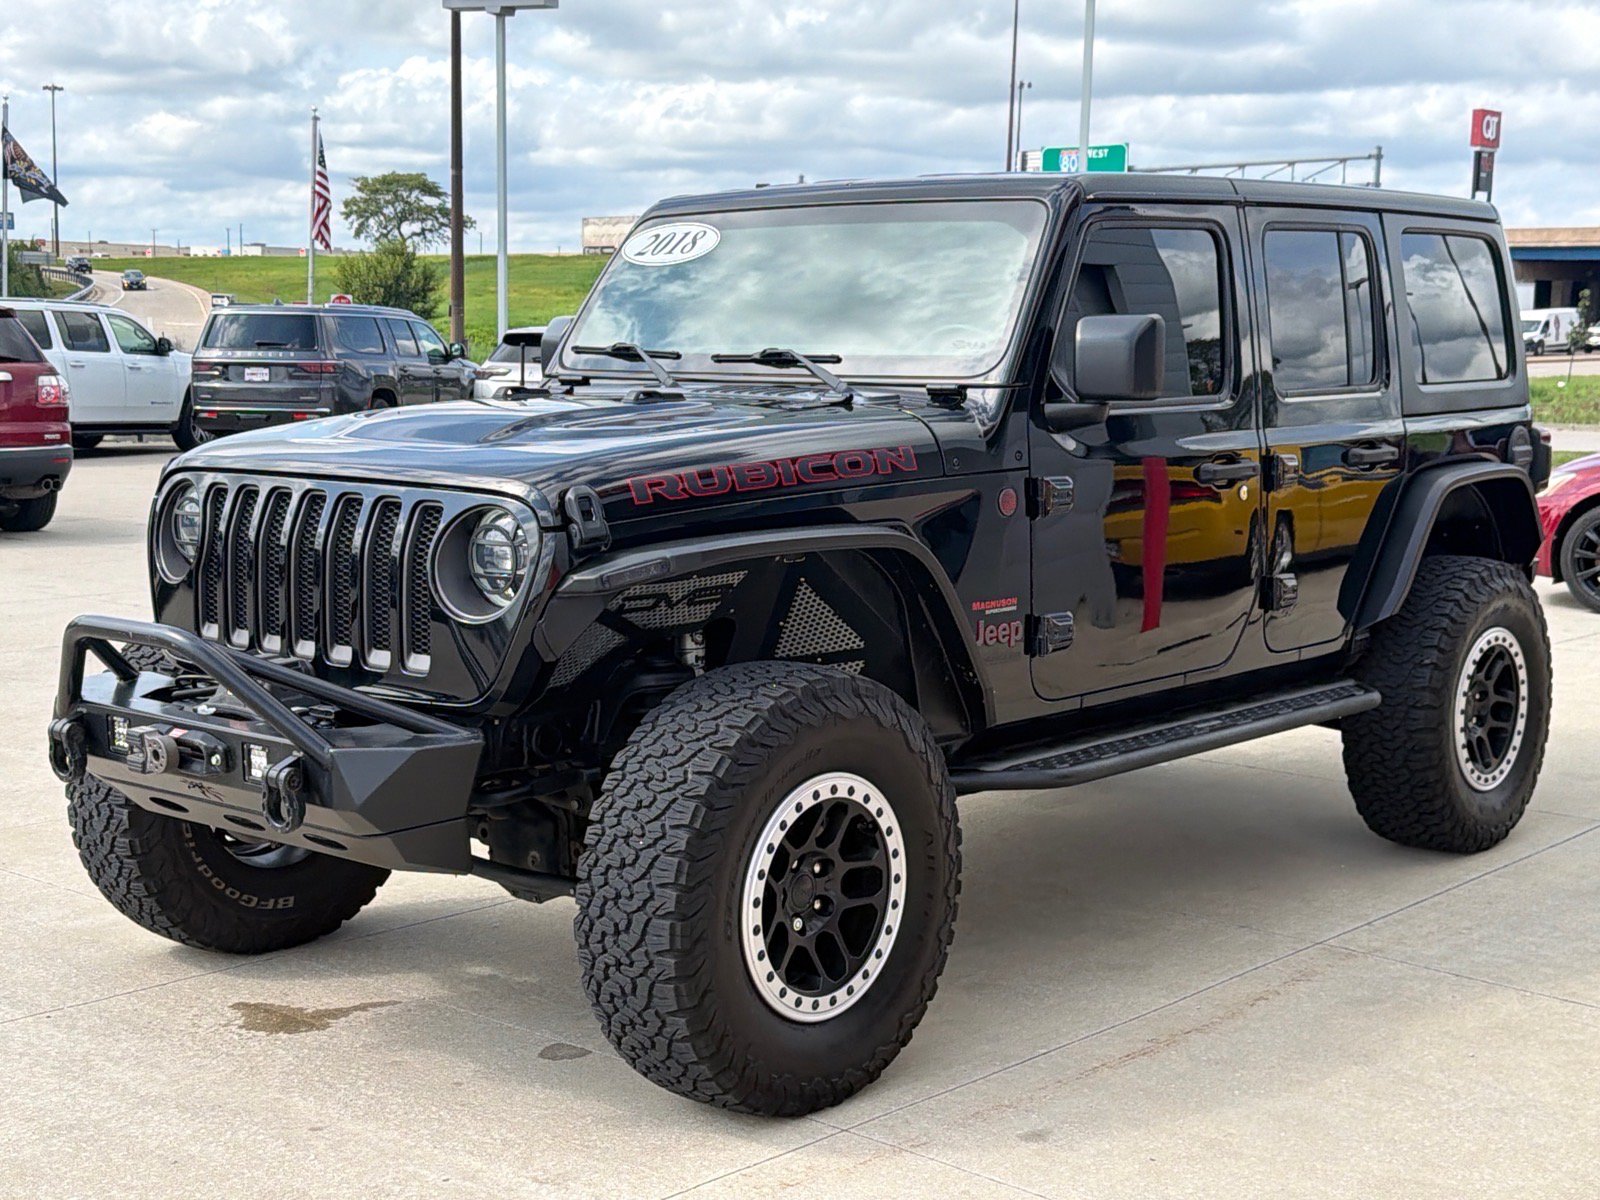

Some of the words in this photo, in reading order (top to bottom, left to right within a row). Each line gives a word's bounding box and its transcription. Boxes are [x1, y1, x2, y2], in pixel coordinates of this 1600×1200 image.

[1061, 155, 1077, 172] 80
[634, 230, 707, 257] 2018
[626, 446, 917, 505] RUBICON
[972, 597, 1018, 611] MAGNUSON
[976, 620, 1023, 648] Jeep
[182, 822, 295, 909] BFGoodric
